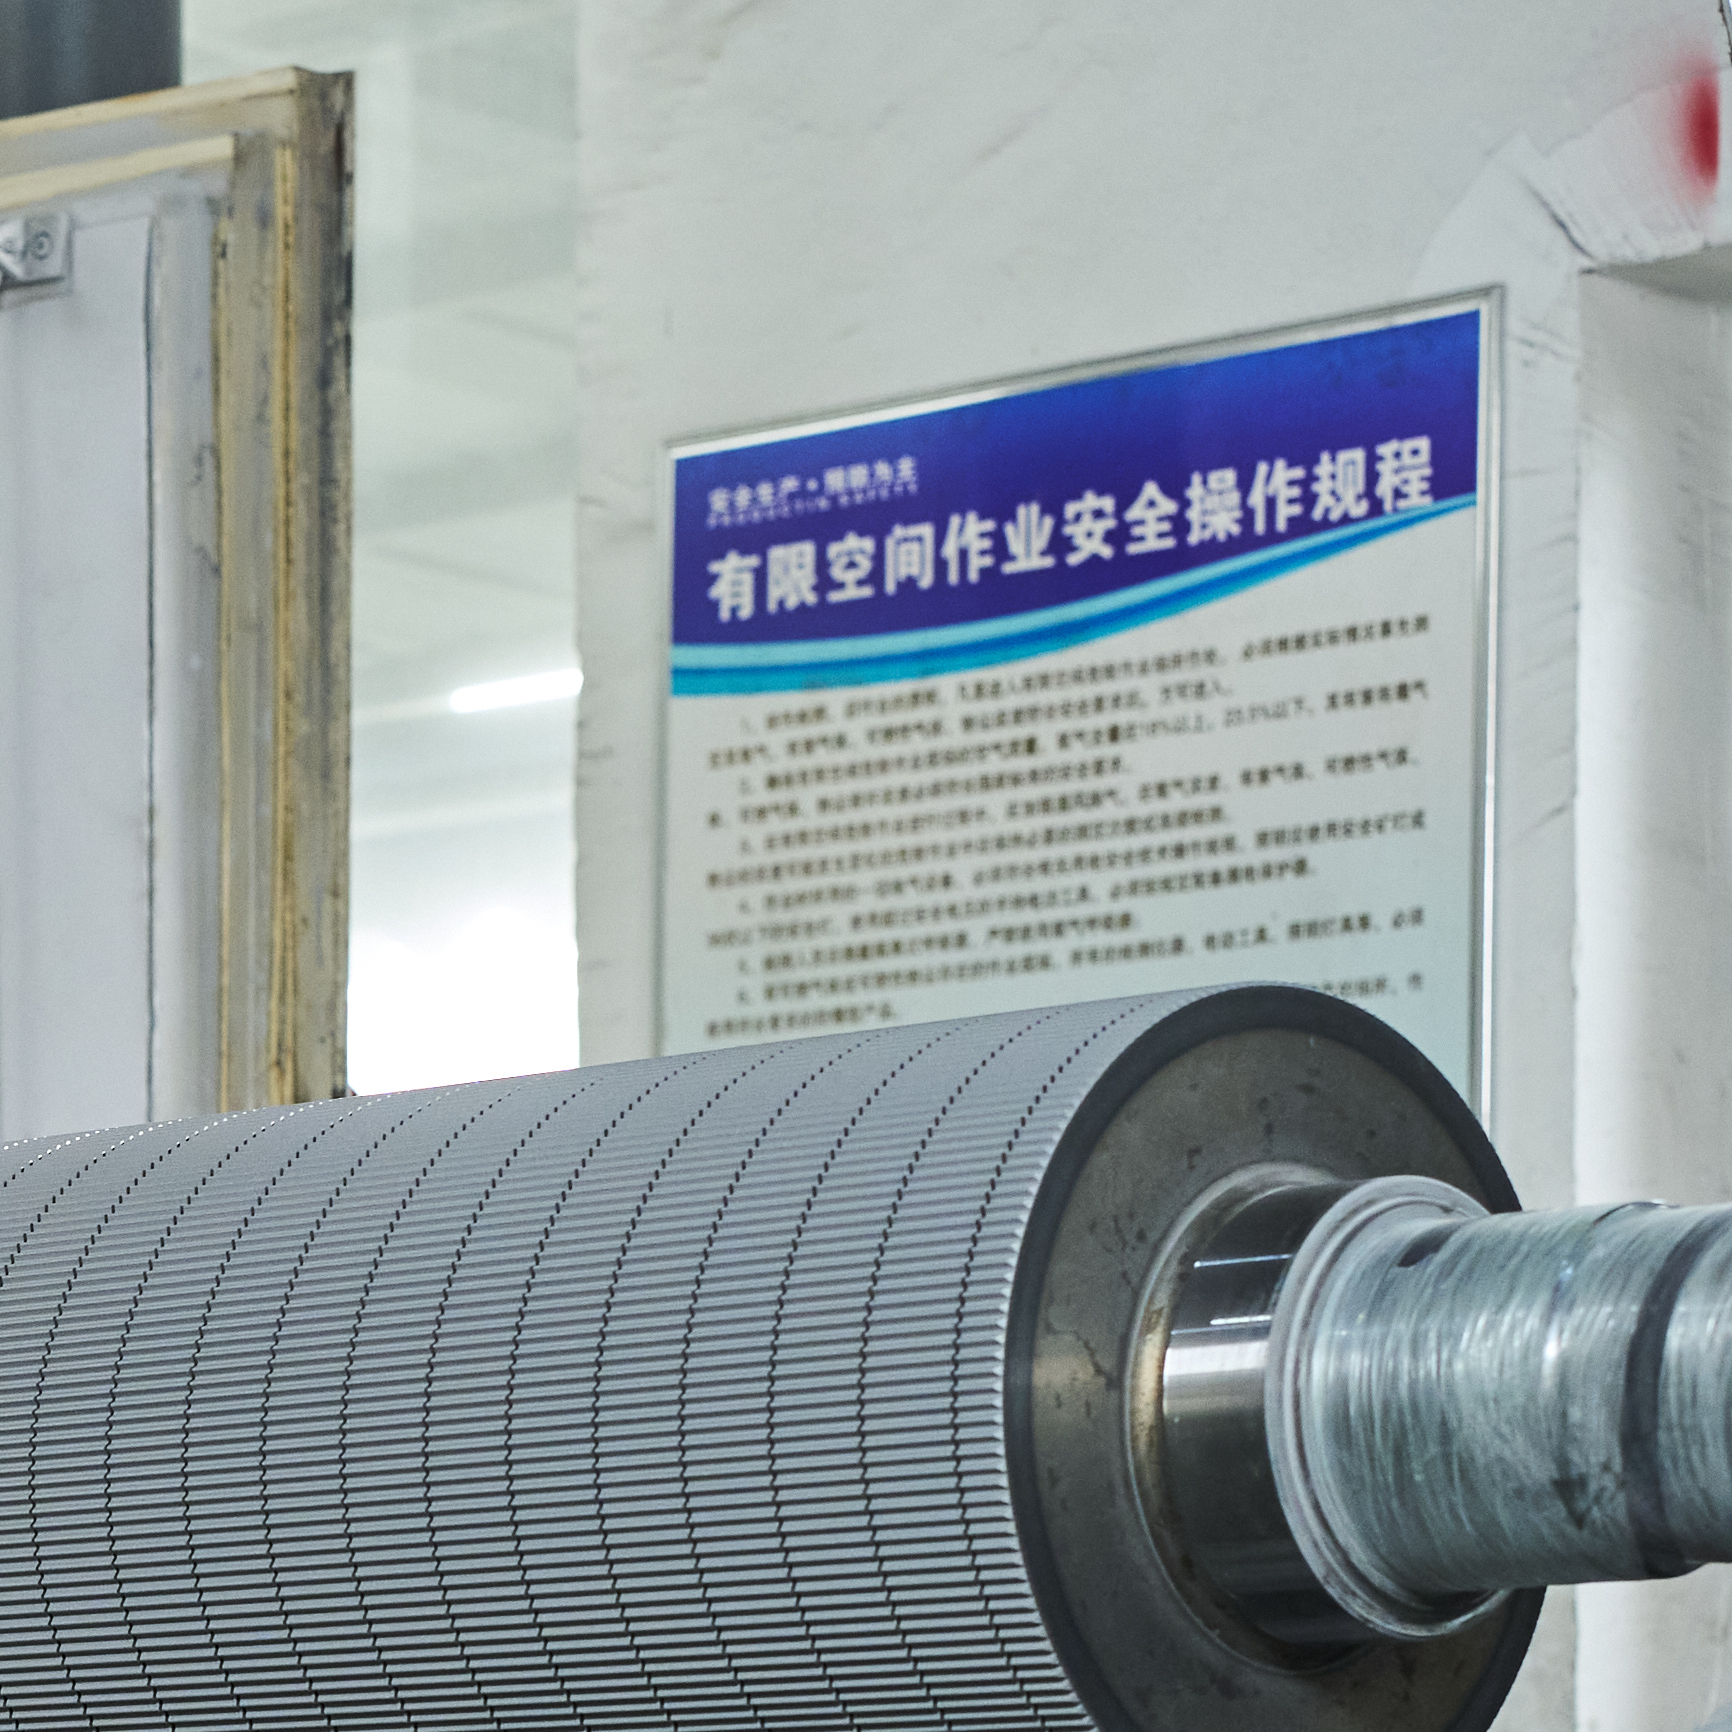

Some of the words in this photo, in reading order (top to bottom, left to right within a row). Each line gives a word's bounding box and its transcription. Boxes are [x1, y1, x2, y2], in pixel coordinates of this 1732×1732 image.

[706, 435, 1435, 623] 有限空间作业安全操作规程
